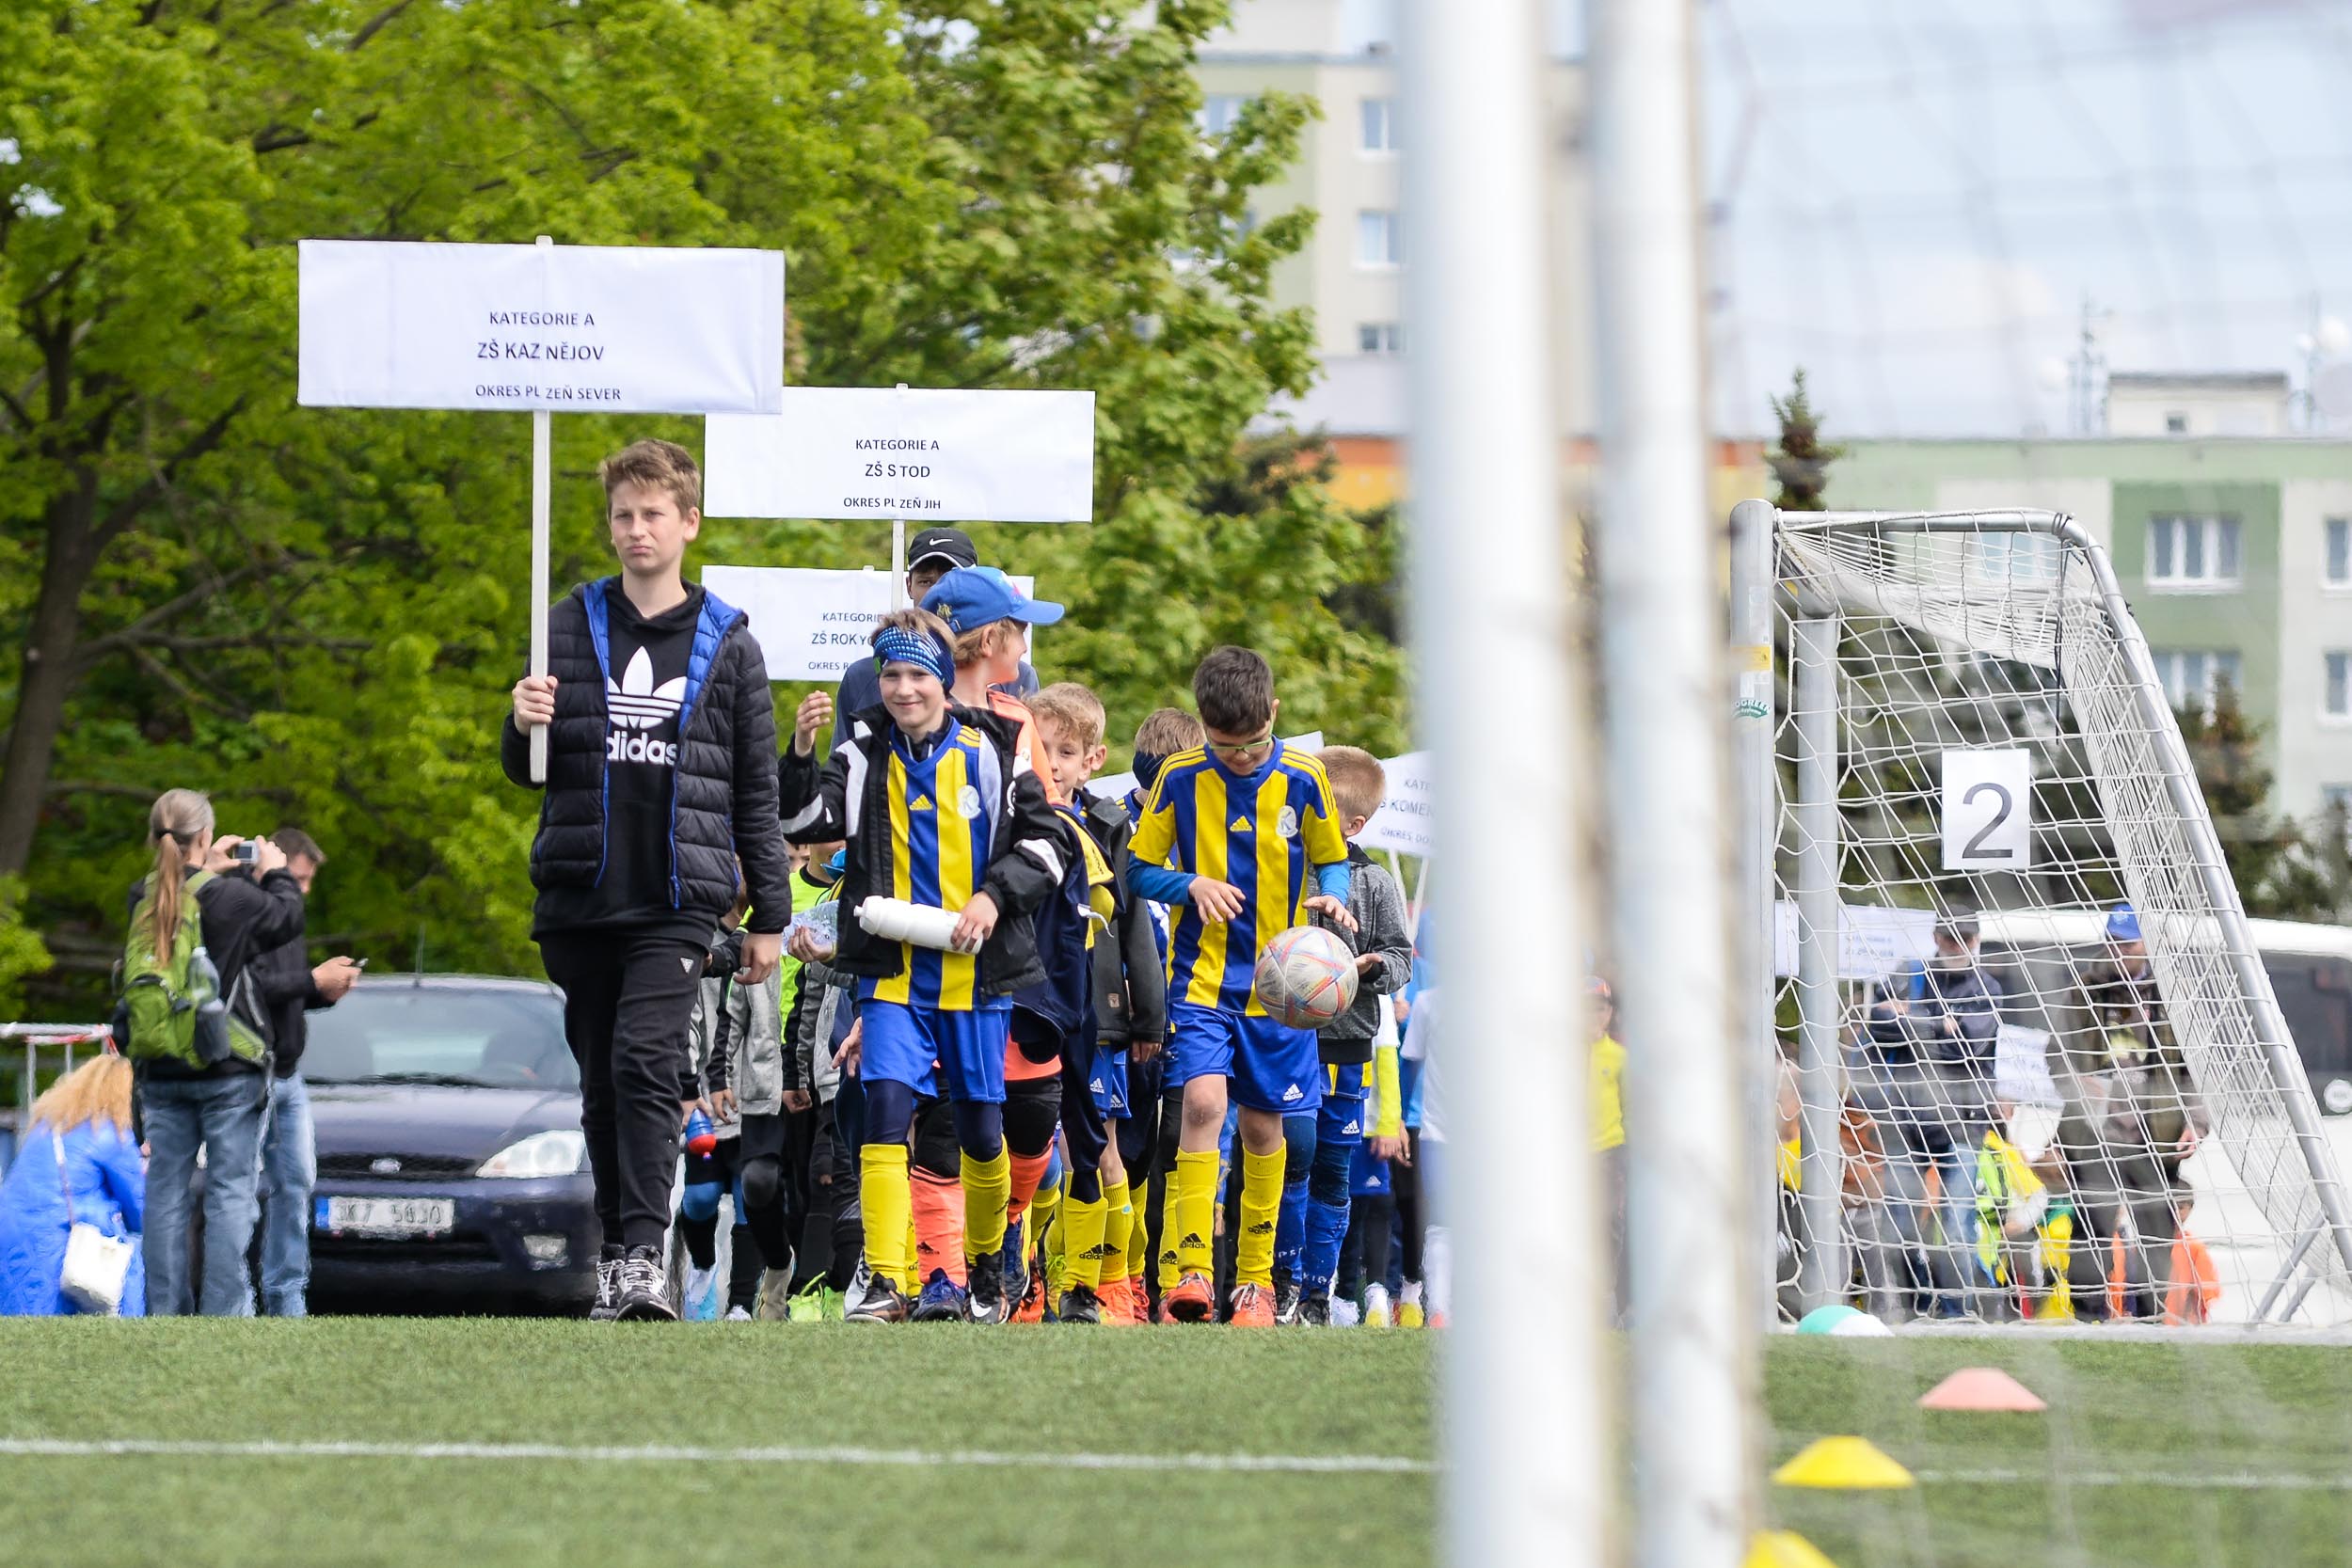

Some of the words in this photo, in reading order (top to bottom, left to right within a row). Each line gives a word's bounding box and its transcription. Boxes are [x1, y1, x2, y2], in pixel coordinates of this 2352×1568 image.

[489, 311, 579, 325] KATEGORIE
[583, 312, 595, 325] A
[477, 339, 500, 359] ZŠ
[475, 384, 521, 397] OKRES
[577, 388, 621, 400] SEVER
[855, 439, 927, 451] KATEGORIE
[930, 439, 940, 451] A
[865, 460, 882, 477] ZŠ
[843, 497, 881, 508] OKRES
[924, 499, 941, 509] JIH
[811, 630, 827, 644] ZŠ
[808, 661, 840, 670] OKRES
[607, 730, 677, 766] didas
[1963, 783, 2012, 858] 2
